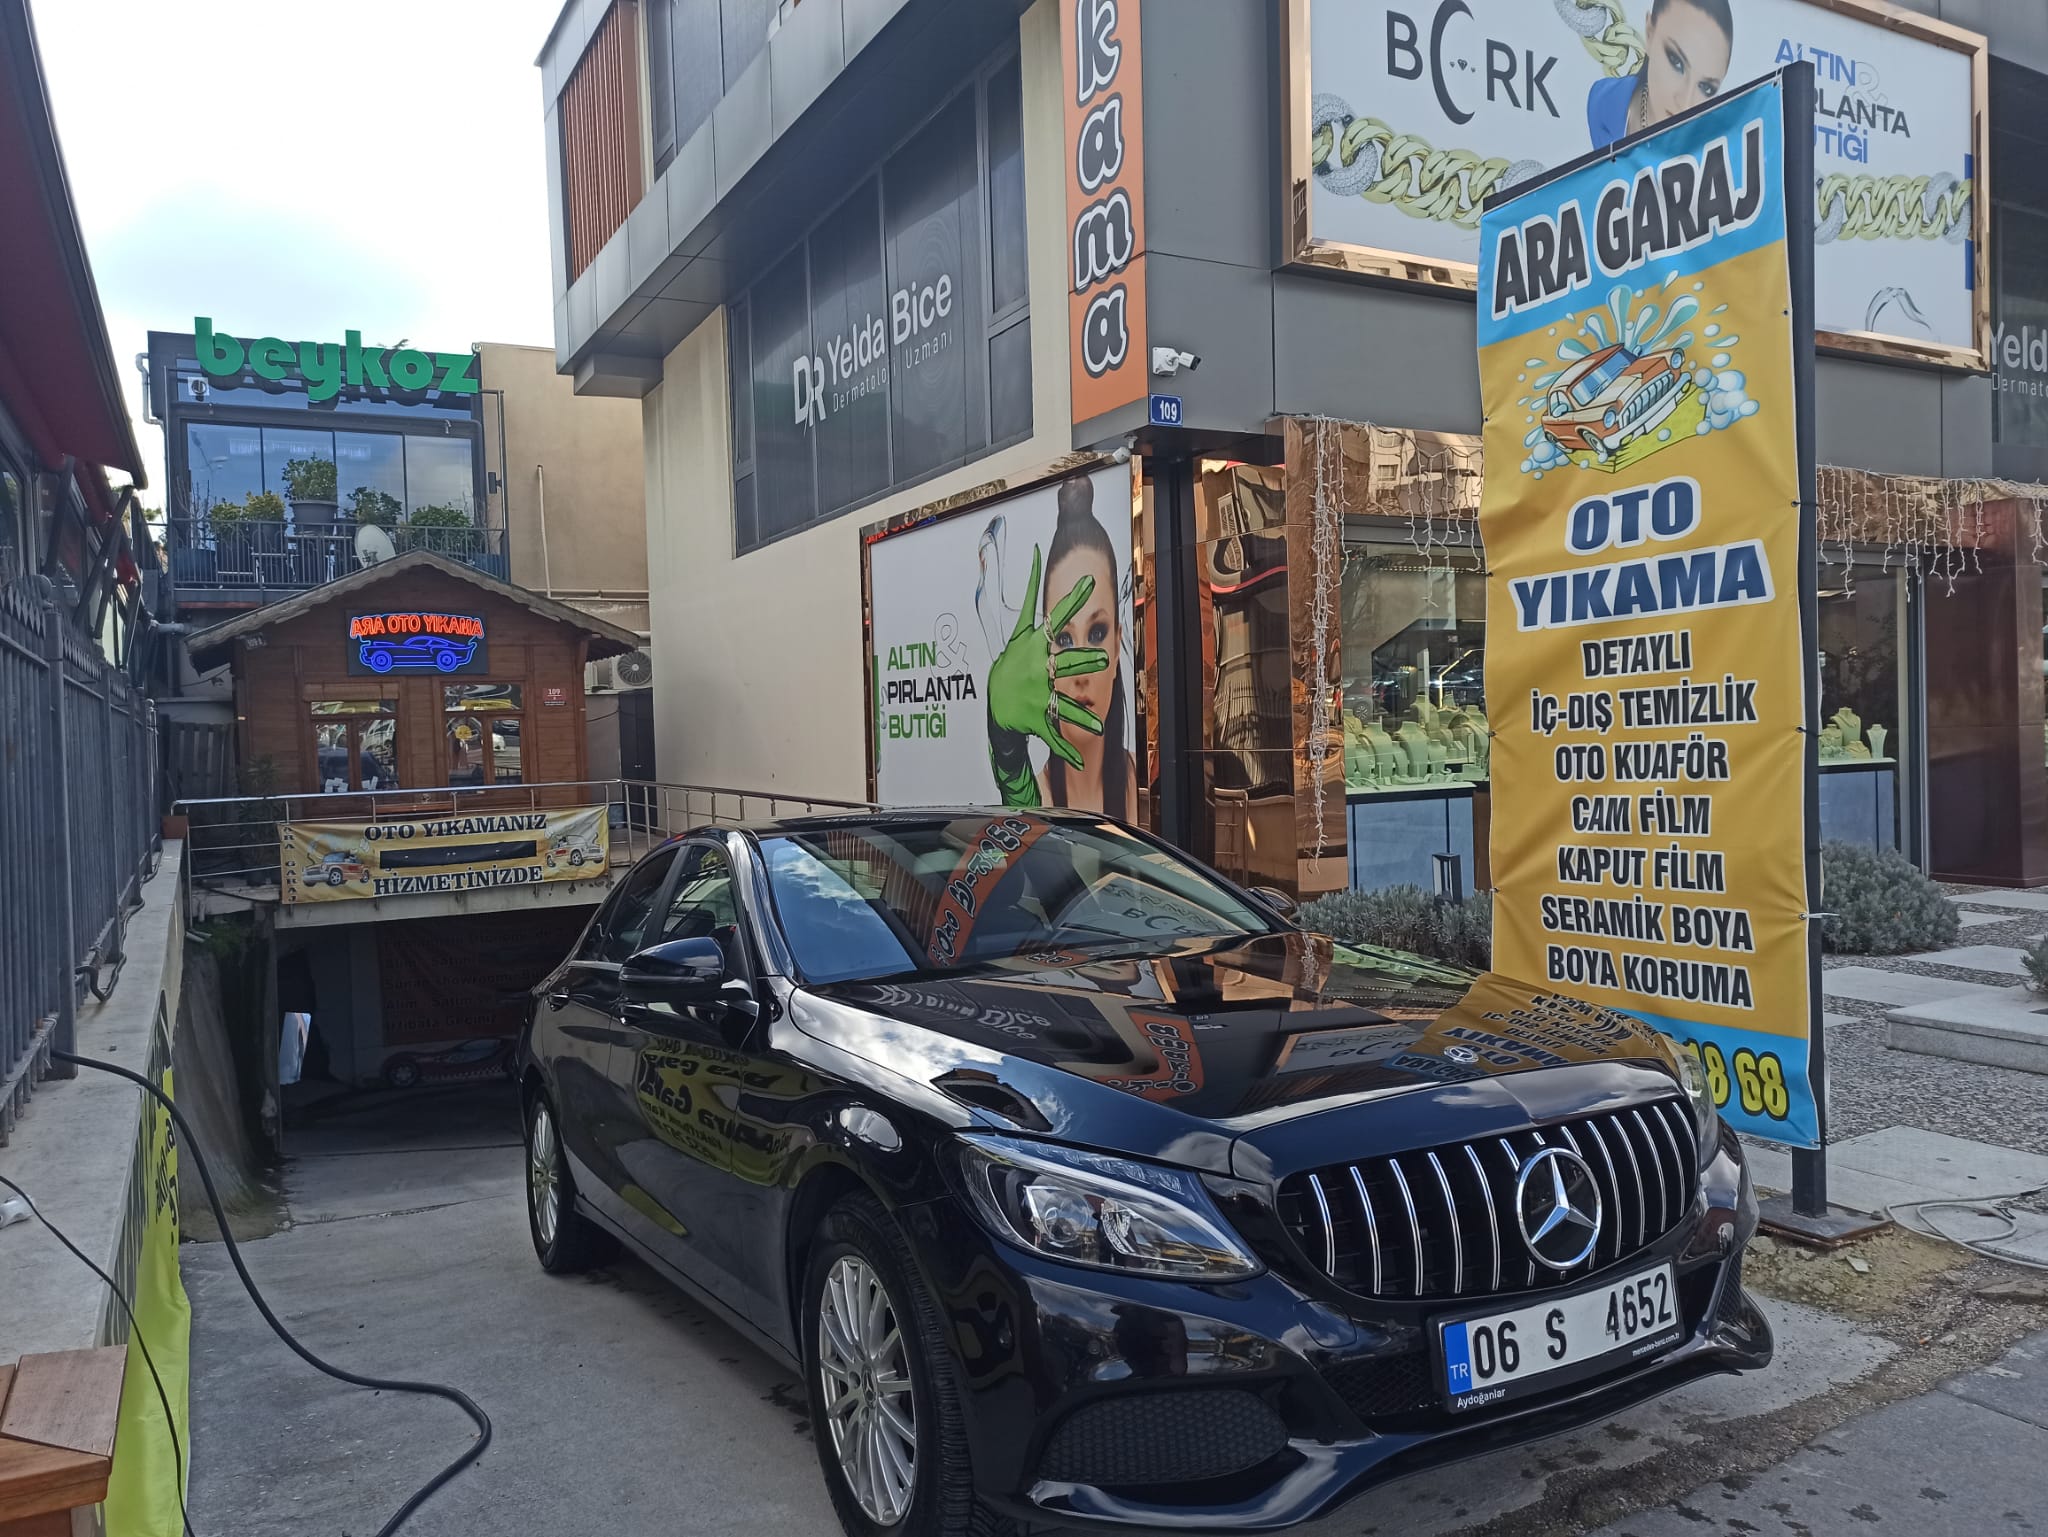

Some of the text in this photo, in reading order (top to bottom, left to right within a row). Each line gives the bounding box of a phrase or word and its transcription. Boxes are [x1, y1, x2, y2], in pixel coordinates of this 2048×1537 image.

[1493, 126, 1762, 316] ARA GARAJ
[826, 274, 952, 386] Yelda Bice
[194, 317, 479, 401] beykoz
[1159, 399, 1177, 422] 109
[1570, 480, 1696, 551] OTO
[1514, 544, 1768, 628] YIKAMA
[387, 614, 421, 633] OTO
[423, 614, 484, 637] YIKAMA
[887, 641, 937, 671] ALTIN
[1582, 632, 1691, 677] DETAYLI
[887, 674, 978, 705] PIRLANTA
[1531, 675, 1757, 735] İÇ-DIŞ TEMİZLİK
[888, 704, 947, 739] BUTİĞİ
[1555, 734, 1729, 780] OTO KUAFÖR
[364, 814, 549, 842] OTO YIKAMANIZ
[1572, 790, 1711, 836] CAM FİLM
[372, 865, 544, 896] HİZMETİNİZDE
[1557, 843, 1726, 892] KAPUT FİLM
[1541, 895, 1755, 953] SERAMİK BOYA
[1547, 945, 1755, 1010] BOYA KORUMA
[1733, 1048, 1790, 1121] 68
[1472, 1272, 1672, 1379] 06 S 4652
[1450, 1362, 1469, 1380] TR
[1456, 1386, 1507, 1409] Aydoğanlar
